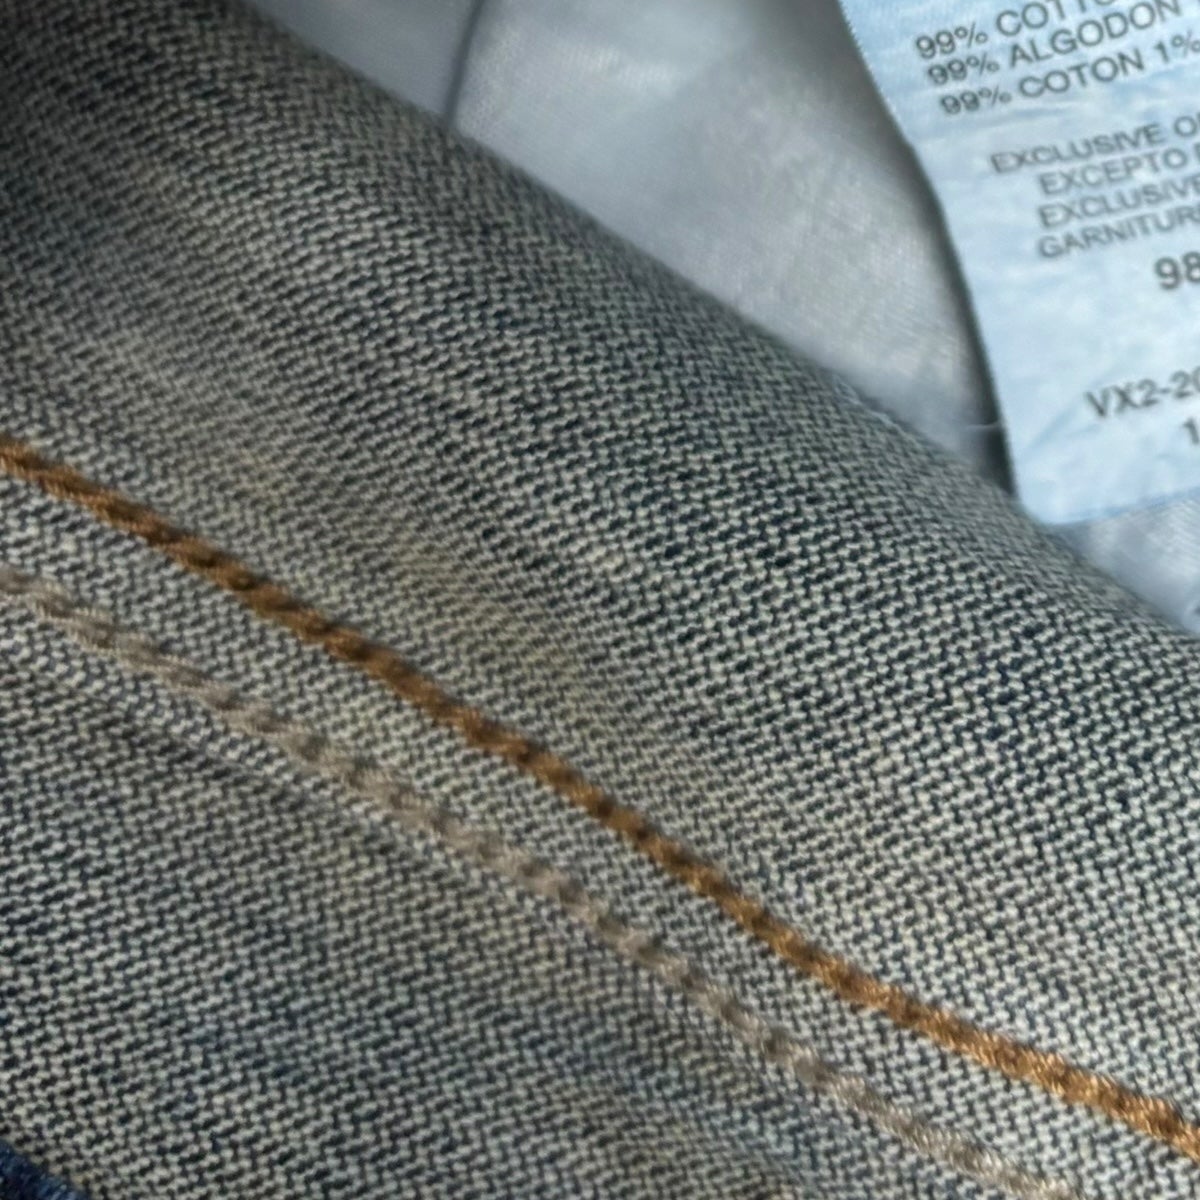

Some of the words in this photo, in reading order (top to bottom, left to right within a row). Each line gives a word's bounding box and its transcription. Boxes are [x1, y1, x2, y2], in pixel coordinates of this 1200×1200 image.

[916, 22, 988, 60] 99%
[928, 53, 1001, 85] 99%
[940, 86, 1013, 115] 99%
[1018, 49, 1146, 98] COTON
[990, 124, 1166, 175] EXCLUSIVE
[1039, 146, 1187, 196] EXCEPTO
